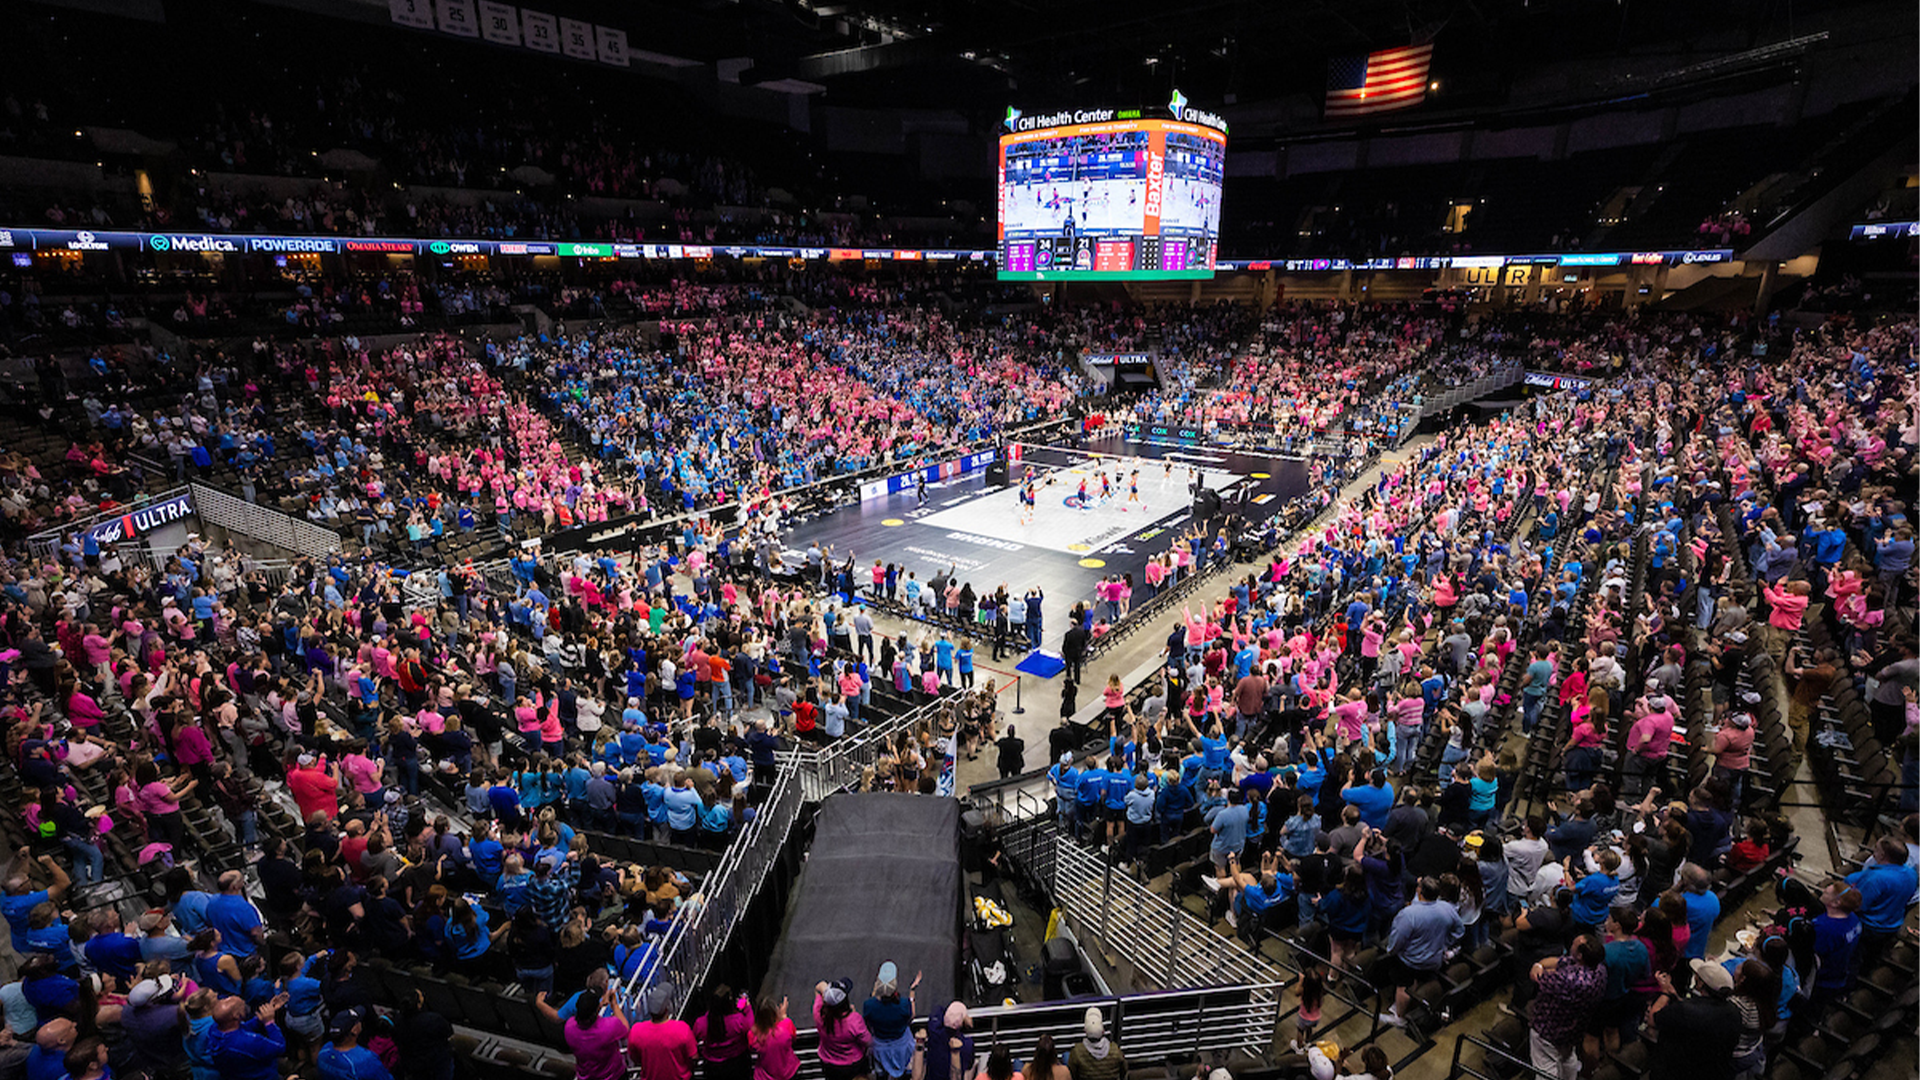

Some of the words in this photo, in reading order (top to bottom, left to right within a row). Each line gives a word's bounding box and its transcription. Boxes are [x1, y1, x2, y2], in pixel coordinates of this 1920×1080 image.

[448, 7, 466, 22] 25
[491, 16, 508, 31] 30
[533, 25, 548, 39] 33
[571, 33, 585, 47] 35
[608, 40, 620, 54] 45
[1019, 116, 1036, 131] CHI
[1037, 111, 1072, 129] Health
[1074, 109, 1114, 124] Center
[1117, 110, 1141, 119] OMAHA
[1184, 108, 1198, 123] CHI
[1146, 151, 1164, 217] Baxter
[171, 236, 239, 252] Medica.
[251, 239, 336, 252] POWERADE
[450, 244, 479, 253] OWEN
[1040, 239, 1052, 249] 24
[1078, 238, 1090, 249] 21
[1120, 355, 1149, 365] ULTRA
[1151, 426, 1169, 436] COX
[1178, 429, 1197, 439] COX
[135, 499, 193, 532] ULTRA
